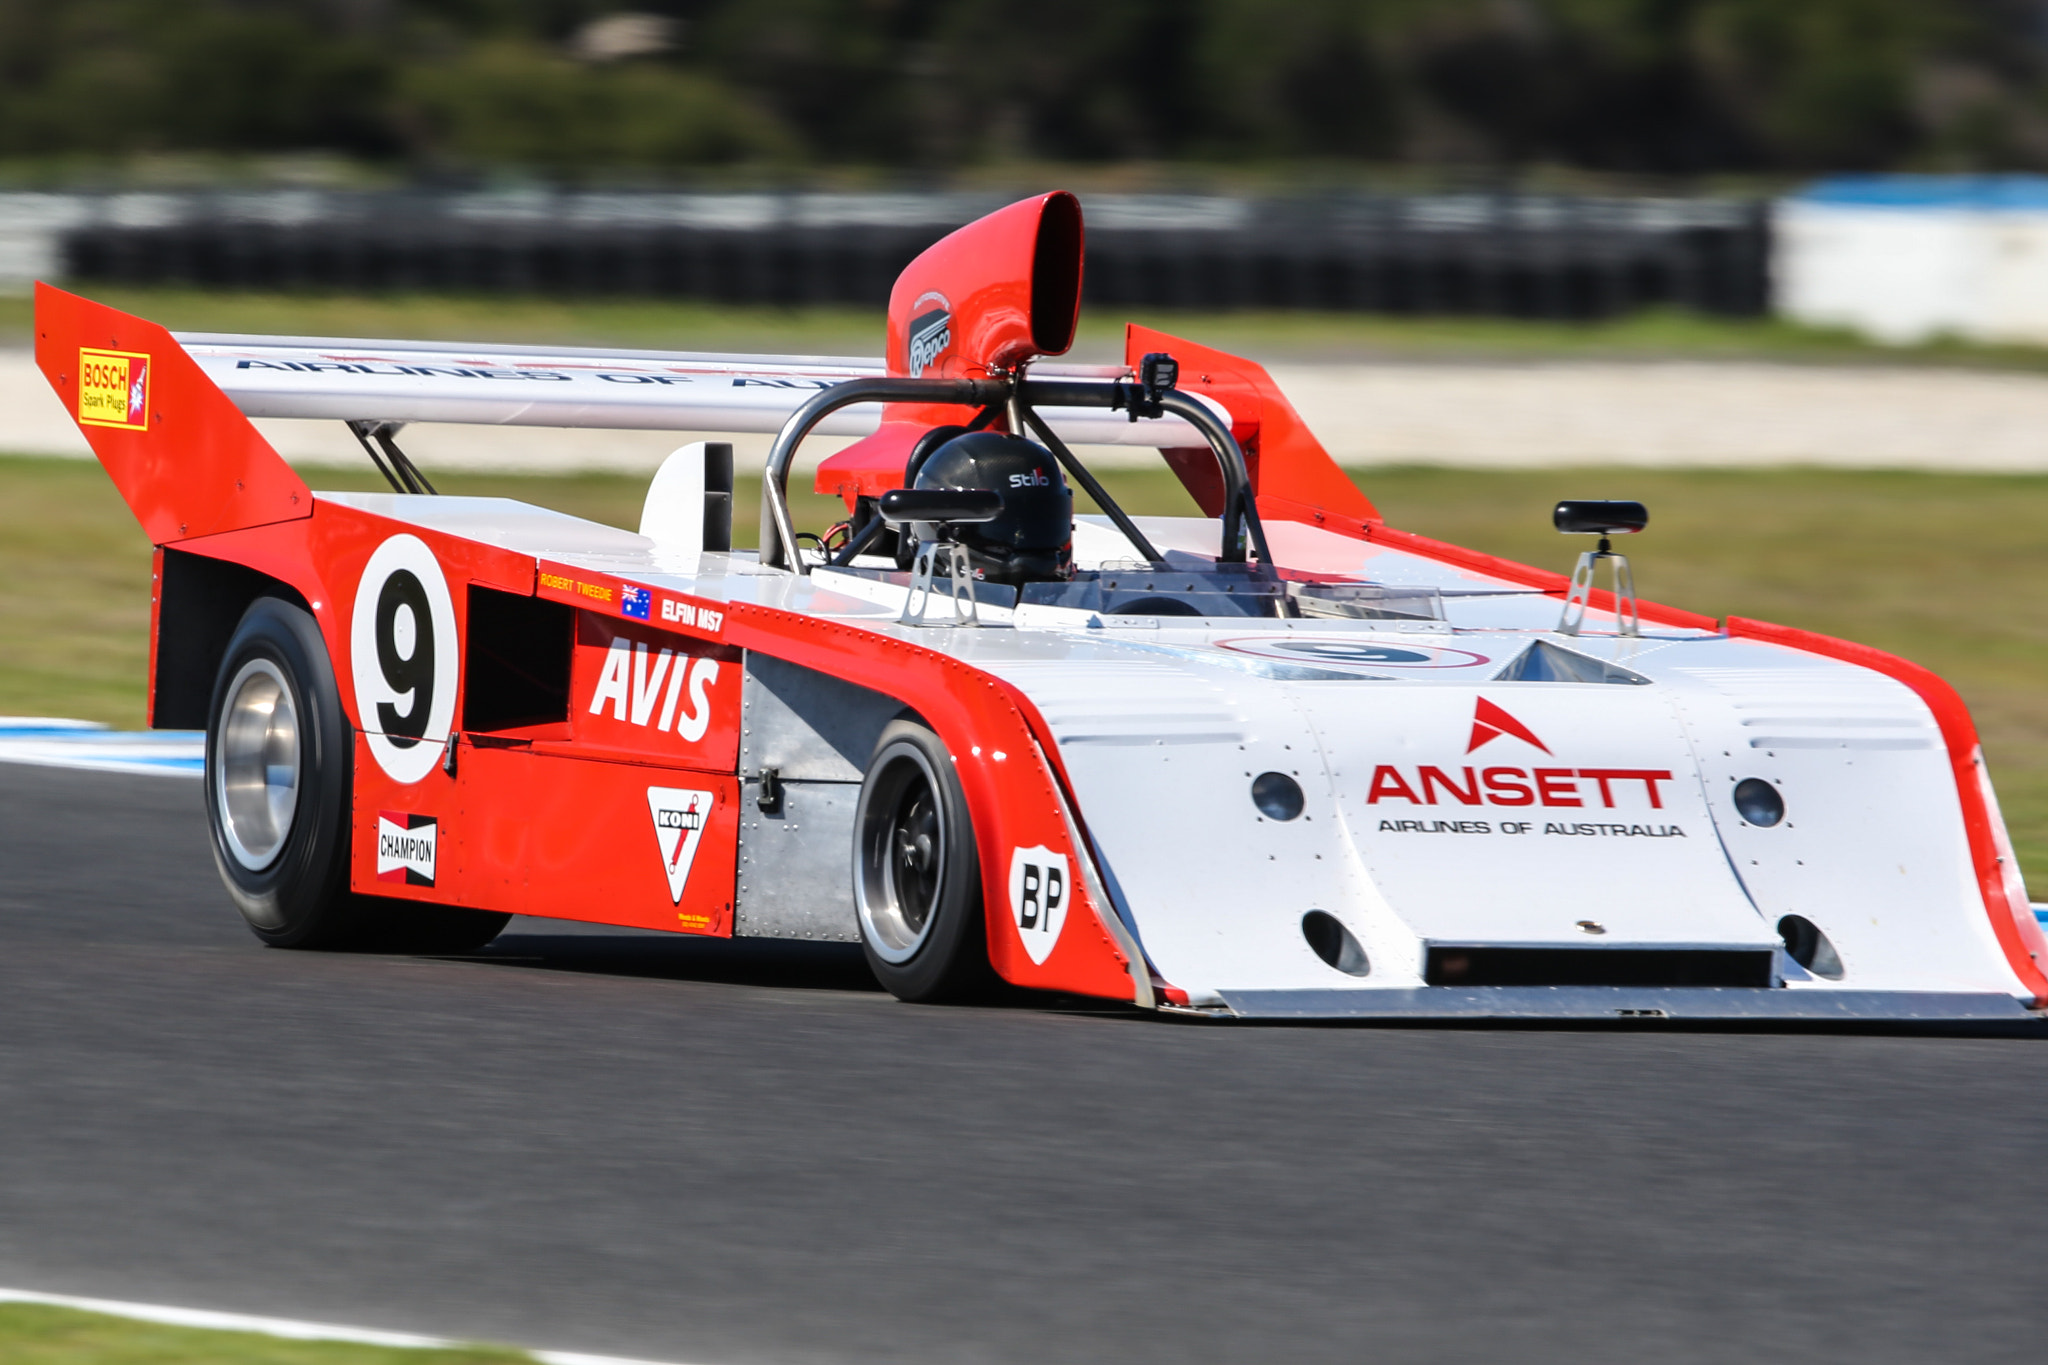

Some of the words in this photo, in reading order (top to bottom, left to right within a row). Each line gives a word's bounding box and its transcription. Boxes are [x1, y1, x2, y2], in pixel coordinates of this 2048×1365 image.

[909, 329, 951, 379] Repco
[84, 362, 127, 392] BOSCH
[235, 359, 574, 382] AIRLINES
[595, 373, 693, 385] OF
[83, 391, 105, 410] Spark
[106, 393, 126, 414] Plugs
[1008, 466, 1050, 488] Stilo
[540, 573, 574, 592] ROBERT
[576, 580, 613, 602] TWEEDIE
[660, 598, 696, 626] ELFIN
[697, 607, 724, 633] MS7
[375, 567, 435, 750] 9
[588, 636, 720, 743] AVIS
[1366, 764, 1674, 809] ANSETT
[660, 810, 699, 829] KONI
[1378, 819, 1493, 835] AIRLINES
[1500, 821, 1534, 835] OF
[1543, 822, 1687, 838] AUSTRALIA
[380, 833, 433, 863] CHAMPION
[1019, 862, 1062, 933] BP
